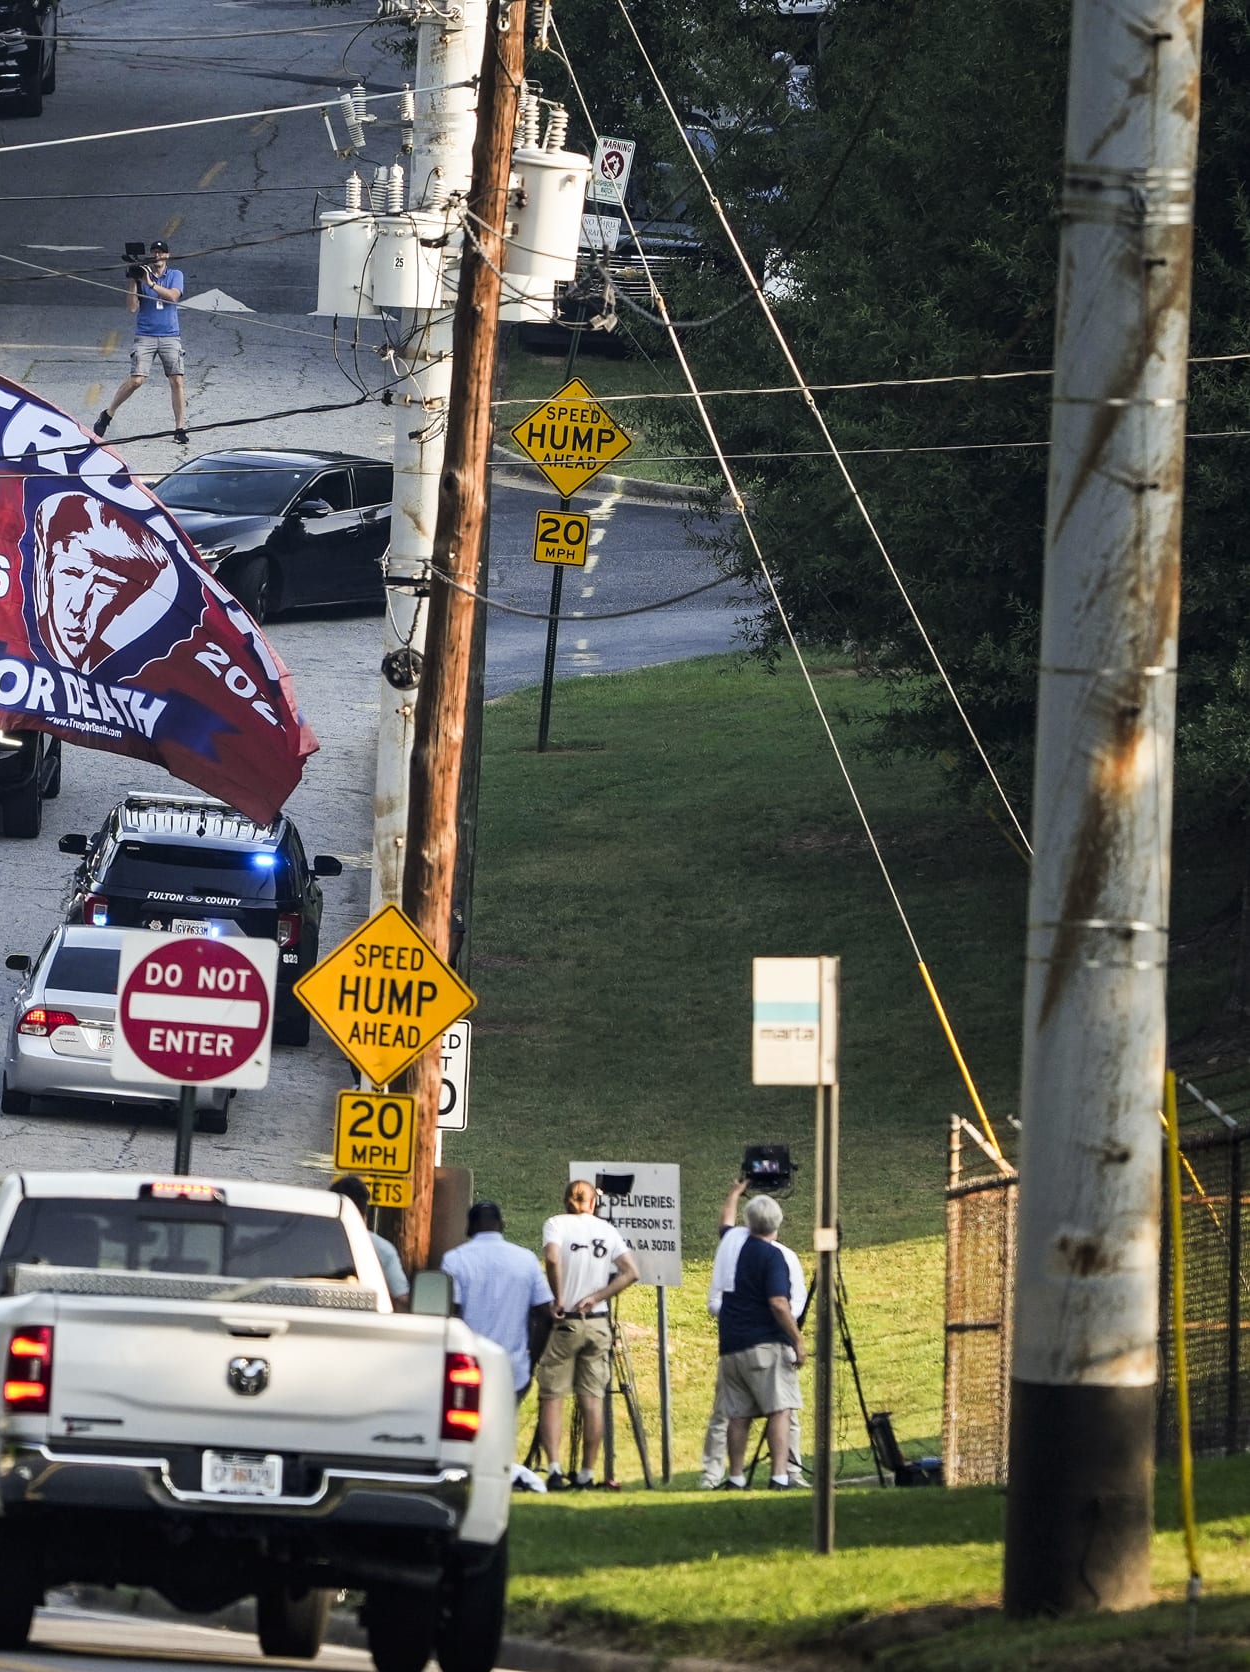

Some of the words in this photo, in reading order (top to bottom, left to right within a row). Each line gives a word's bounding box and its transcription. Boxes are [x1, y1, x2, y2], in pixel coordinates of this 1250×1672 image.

[602, 140, 632, 153] WARNING
[395, 258, 404, 268] 25
[546, 406, 600, 424] SPEED
[527, 422, 616, 454] HUMP
[542, 453, 597, 470] AHEAD
[539, 517, 584, 545] 20
[545, 548, 576, 560] MPH
[195, 642, 286, 732] 202
[60, 670, 167, 738] DEATH
[147, 891, 184, 902] FULTON
[205, 896, 241, 906] COUNTY
[354, 943, 424, 971] SPEED
[145, 962, 183, 986] DO
[197, 966, 251, 992] NOT
[338, 975, 438, 1017] HUMP
[148, 1028, 233, 1057] ENTER
[348, 1021, 421, 1049] AHEAD
[760, 1027, 814, 1041] marta
[348, 1100, 404, 1140] 20
[352, 1144, 396, 1166] MPH
[611, 1194, 675, 1209] DELIVERIES:
[637, 1239, 649, 1249] GA
